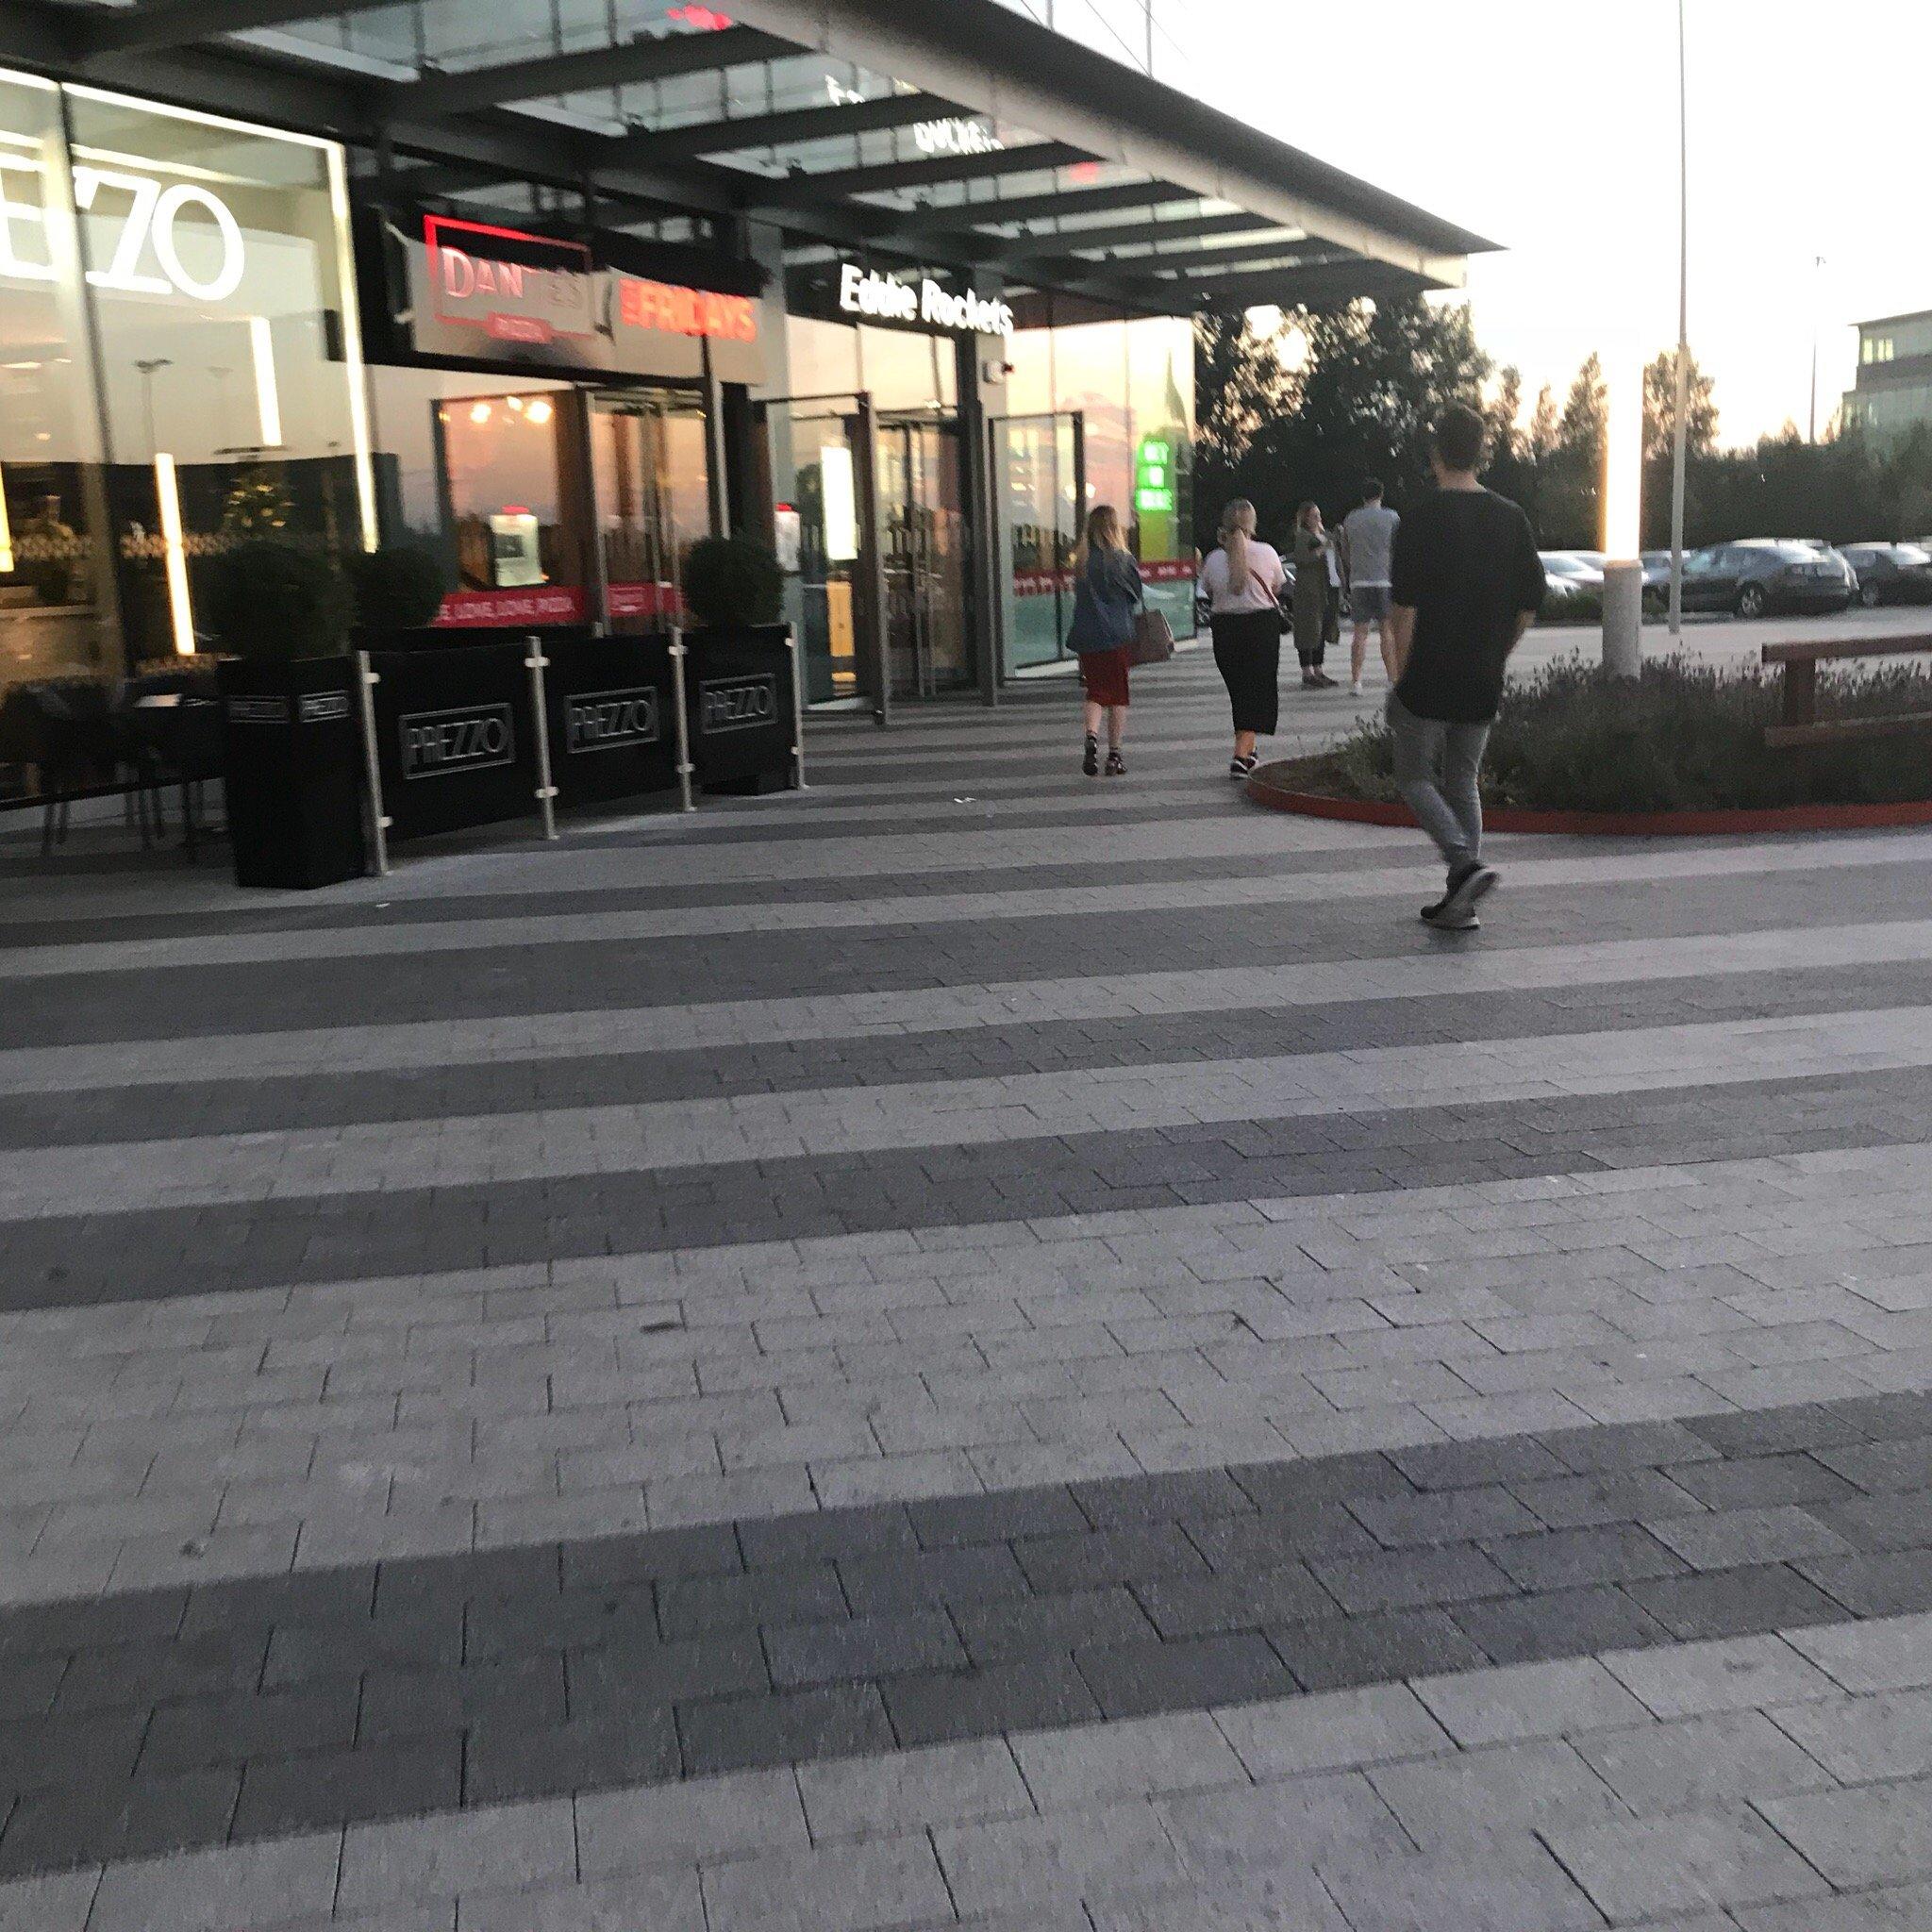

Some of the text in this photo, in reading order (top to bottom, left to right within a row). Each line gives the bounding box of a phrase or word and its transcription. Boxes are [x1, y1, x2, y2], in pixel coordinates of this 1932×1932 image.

[840, 263, 1014, 337] Eddie Rockets
[407, 717, 507, 766] PREZZO
[569, 699, 651, 741] PREZZO
